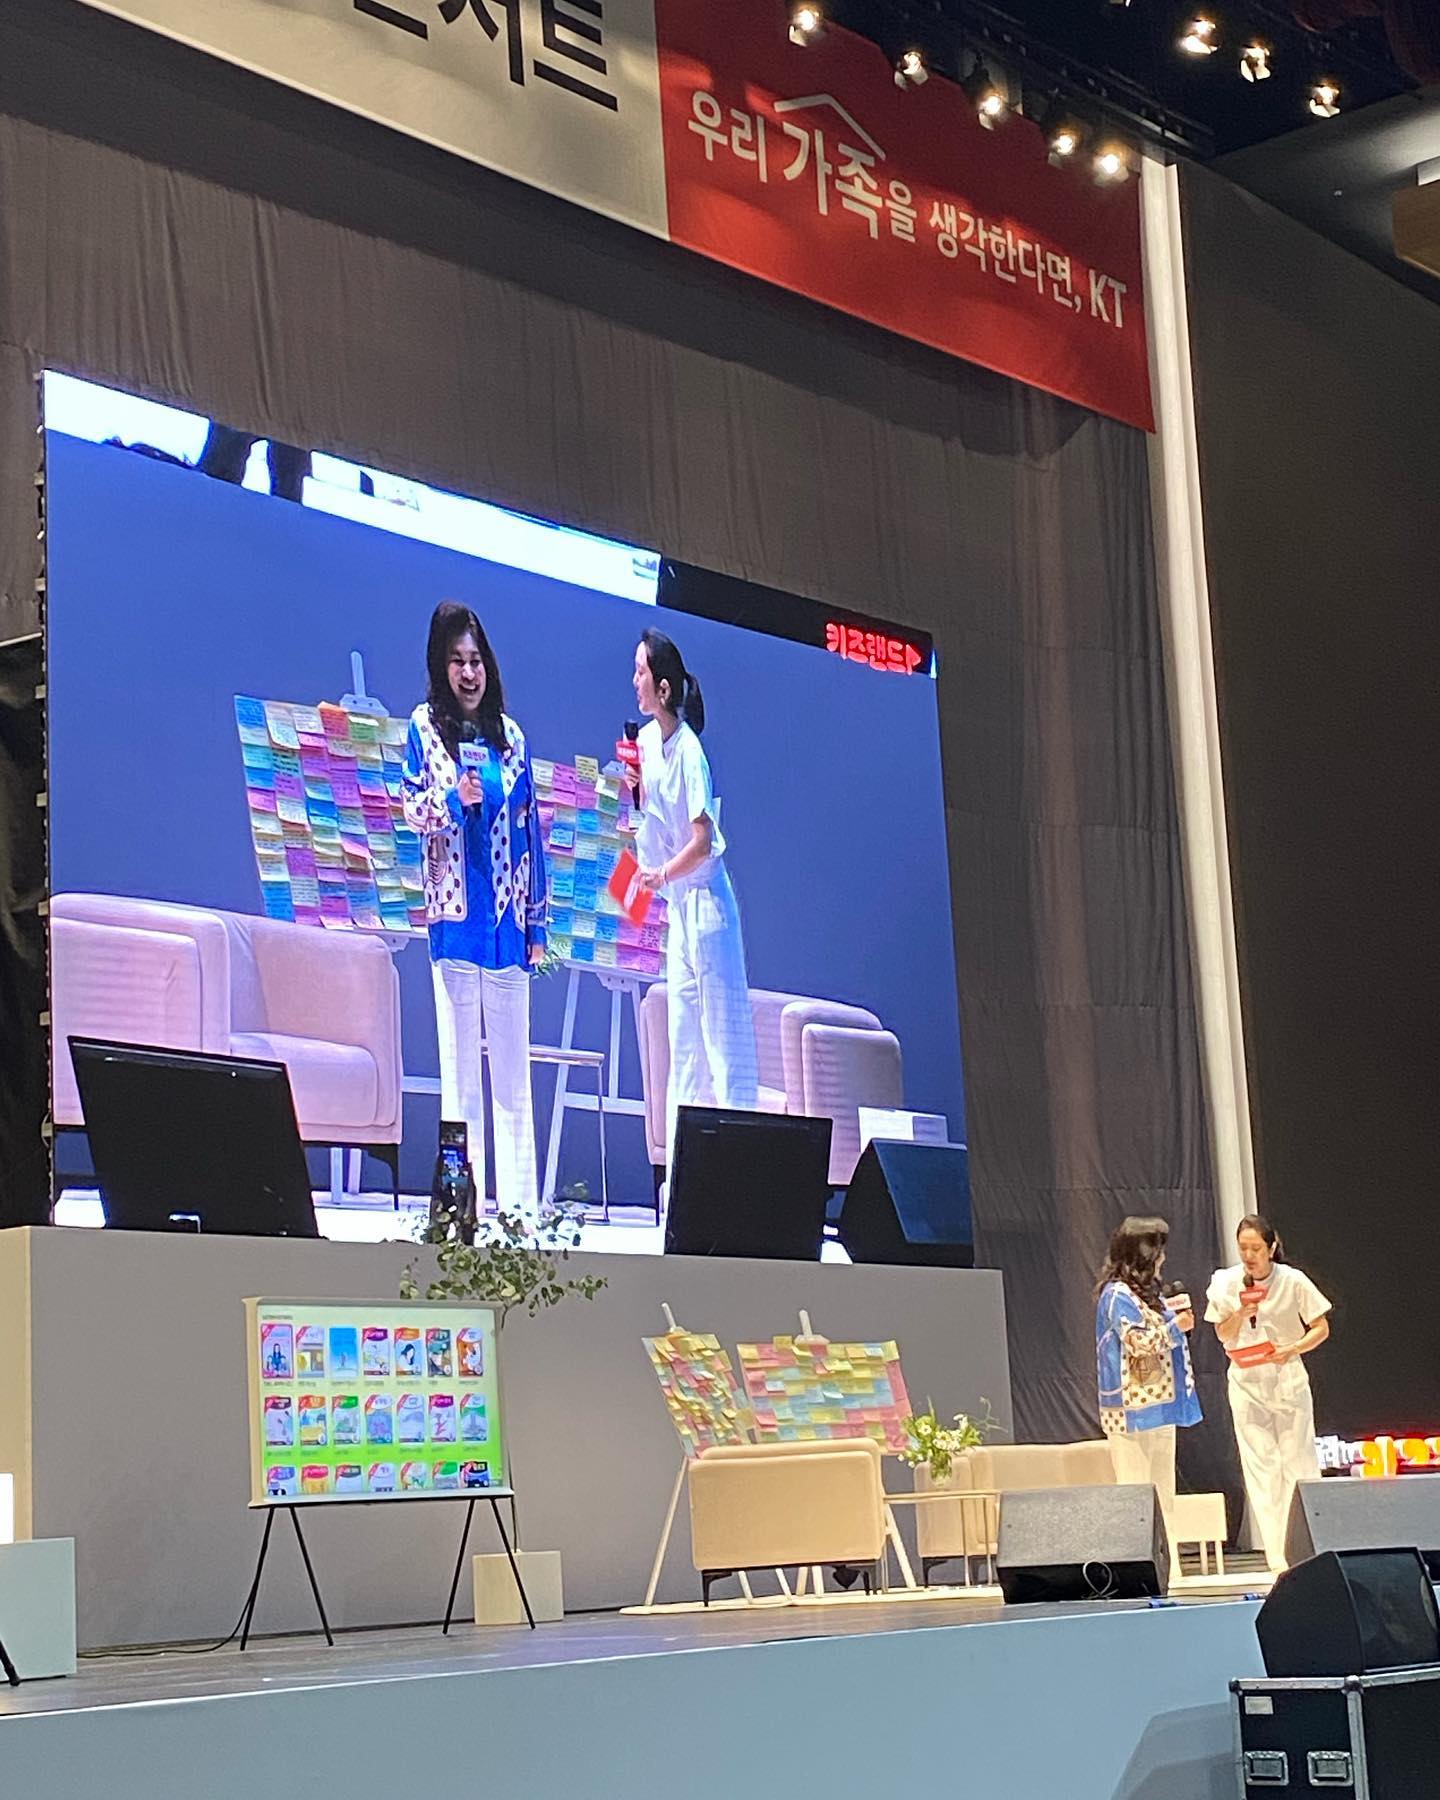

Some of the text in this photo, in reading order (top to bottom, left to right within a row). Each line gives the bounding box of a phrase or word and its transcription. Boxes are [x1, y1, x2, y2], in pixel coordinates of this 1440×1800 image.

[688, 91, 767, 183] 우리
[780, 121, 917, 243] 가족을
[1088, 268, 1127, 328] KT
[826, 623, 906, 673] 키즈랜드
